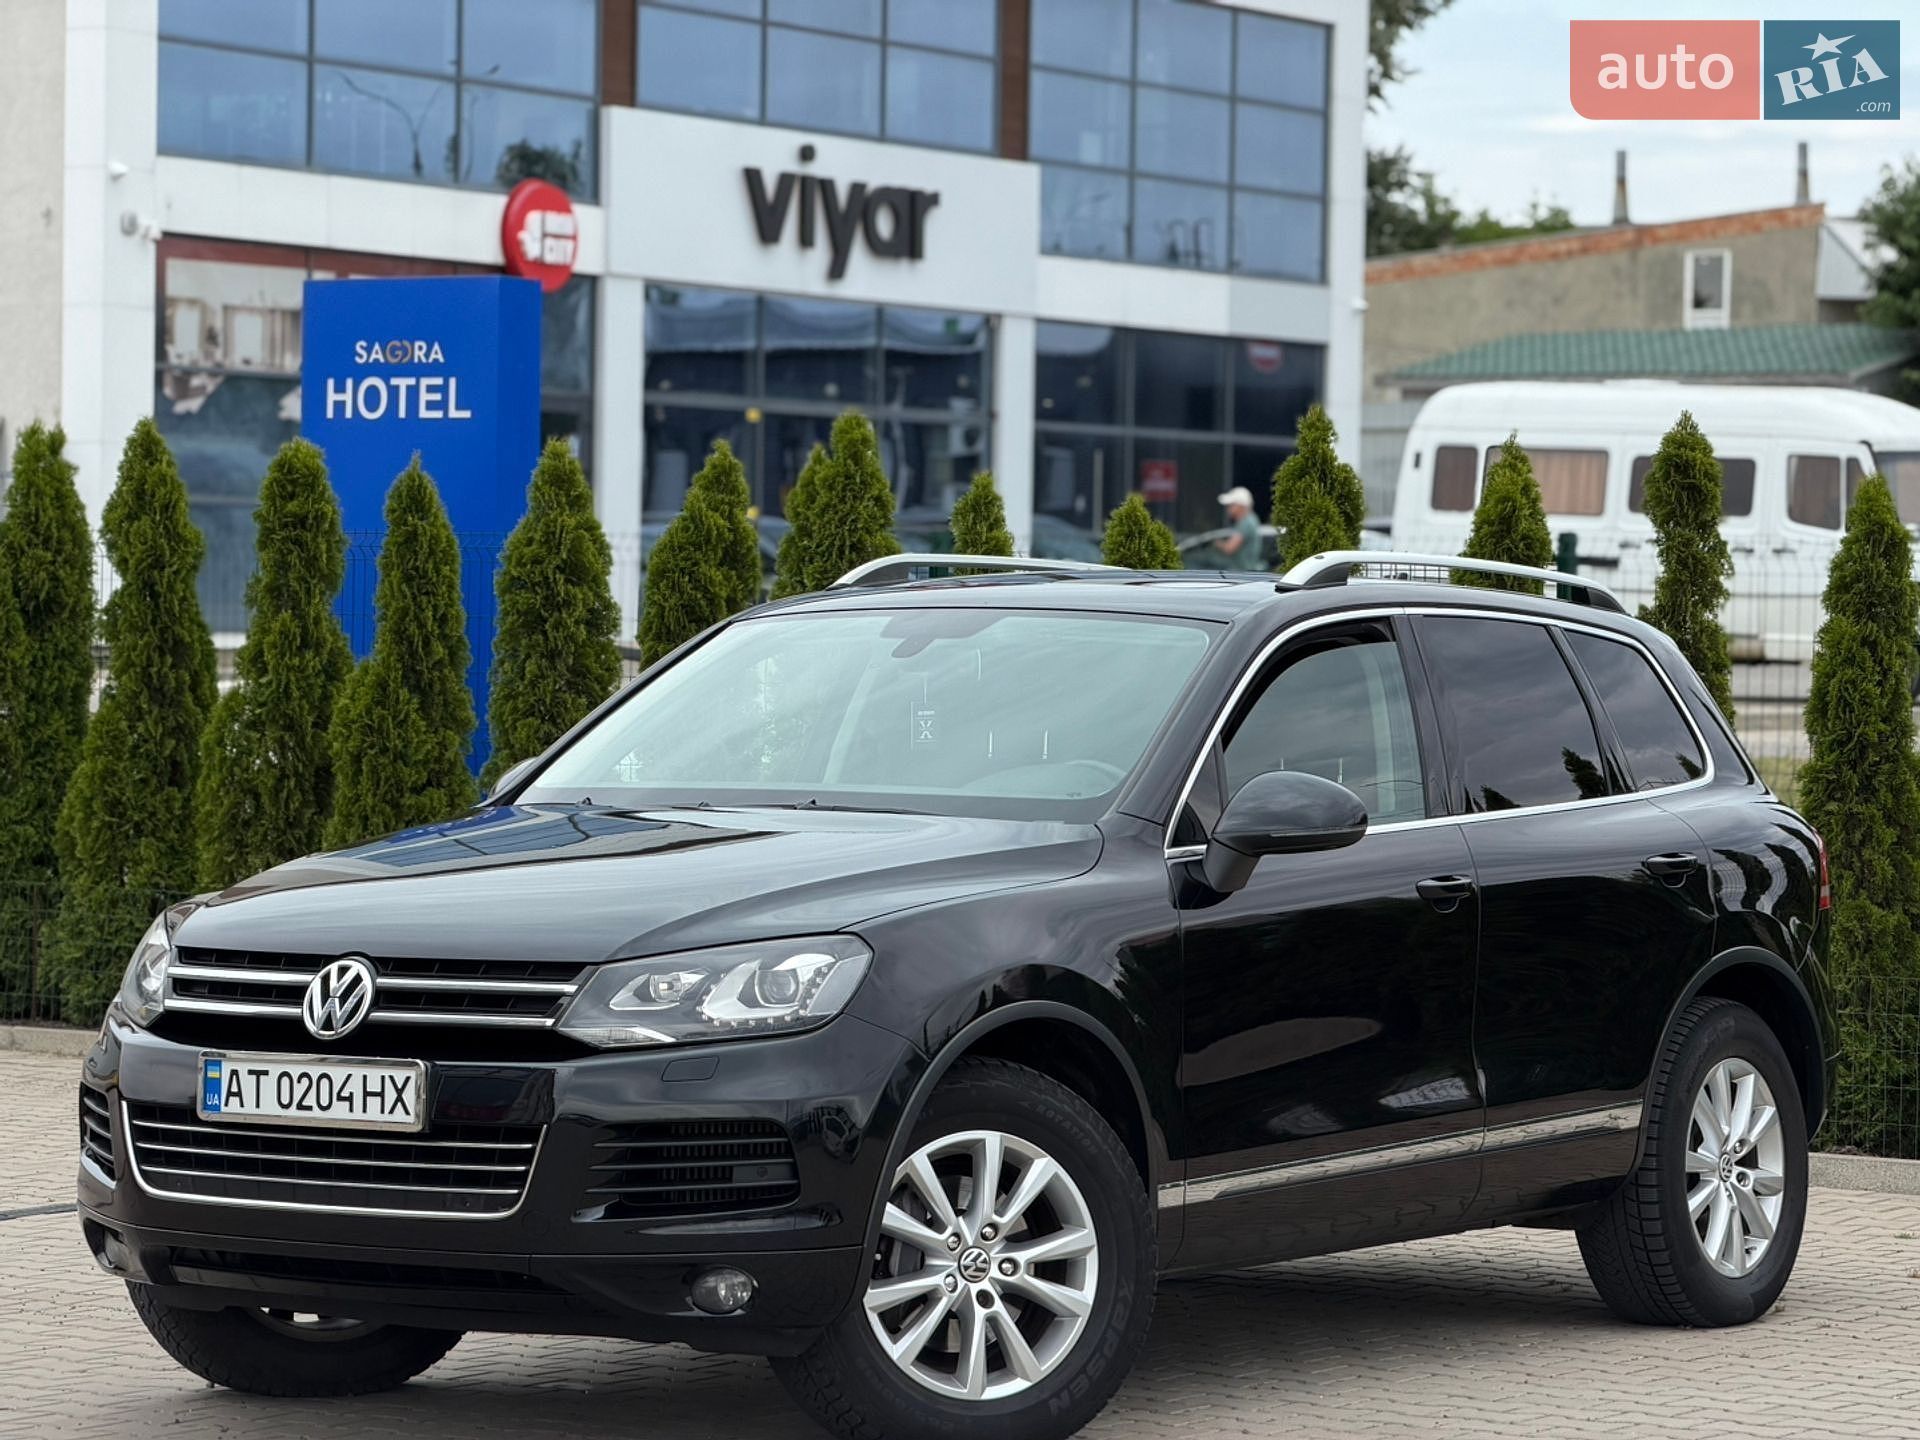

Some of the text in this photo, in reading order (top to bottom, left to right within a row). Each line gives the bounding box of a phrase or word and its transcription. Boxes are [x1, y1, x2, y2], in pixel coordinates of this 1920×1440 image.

[743, 145, 939, 279] viyar
[326, 376, 472, 420] HOTEL
[206, 1093, 219, 1106] UA
